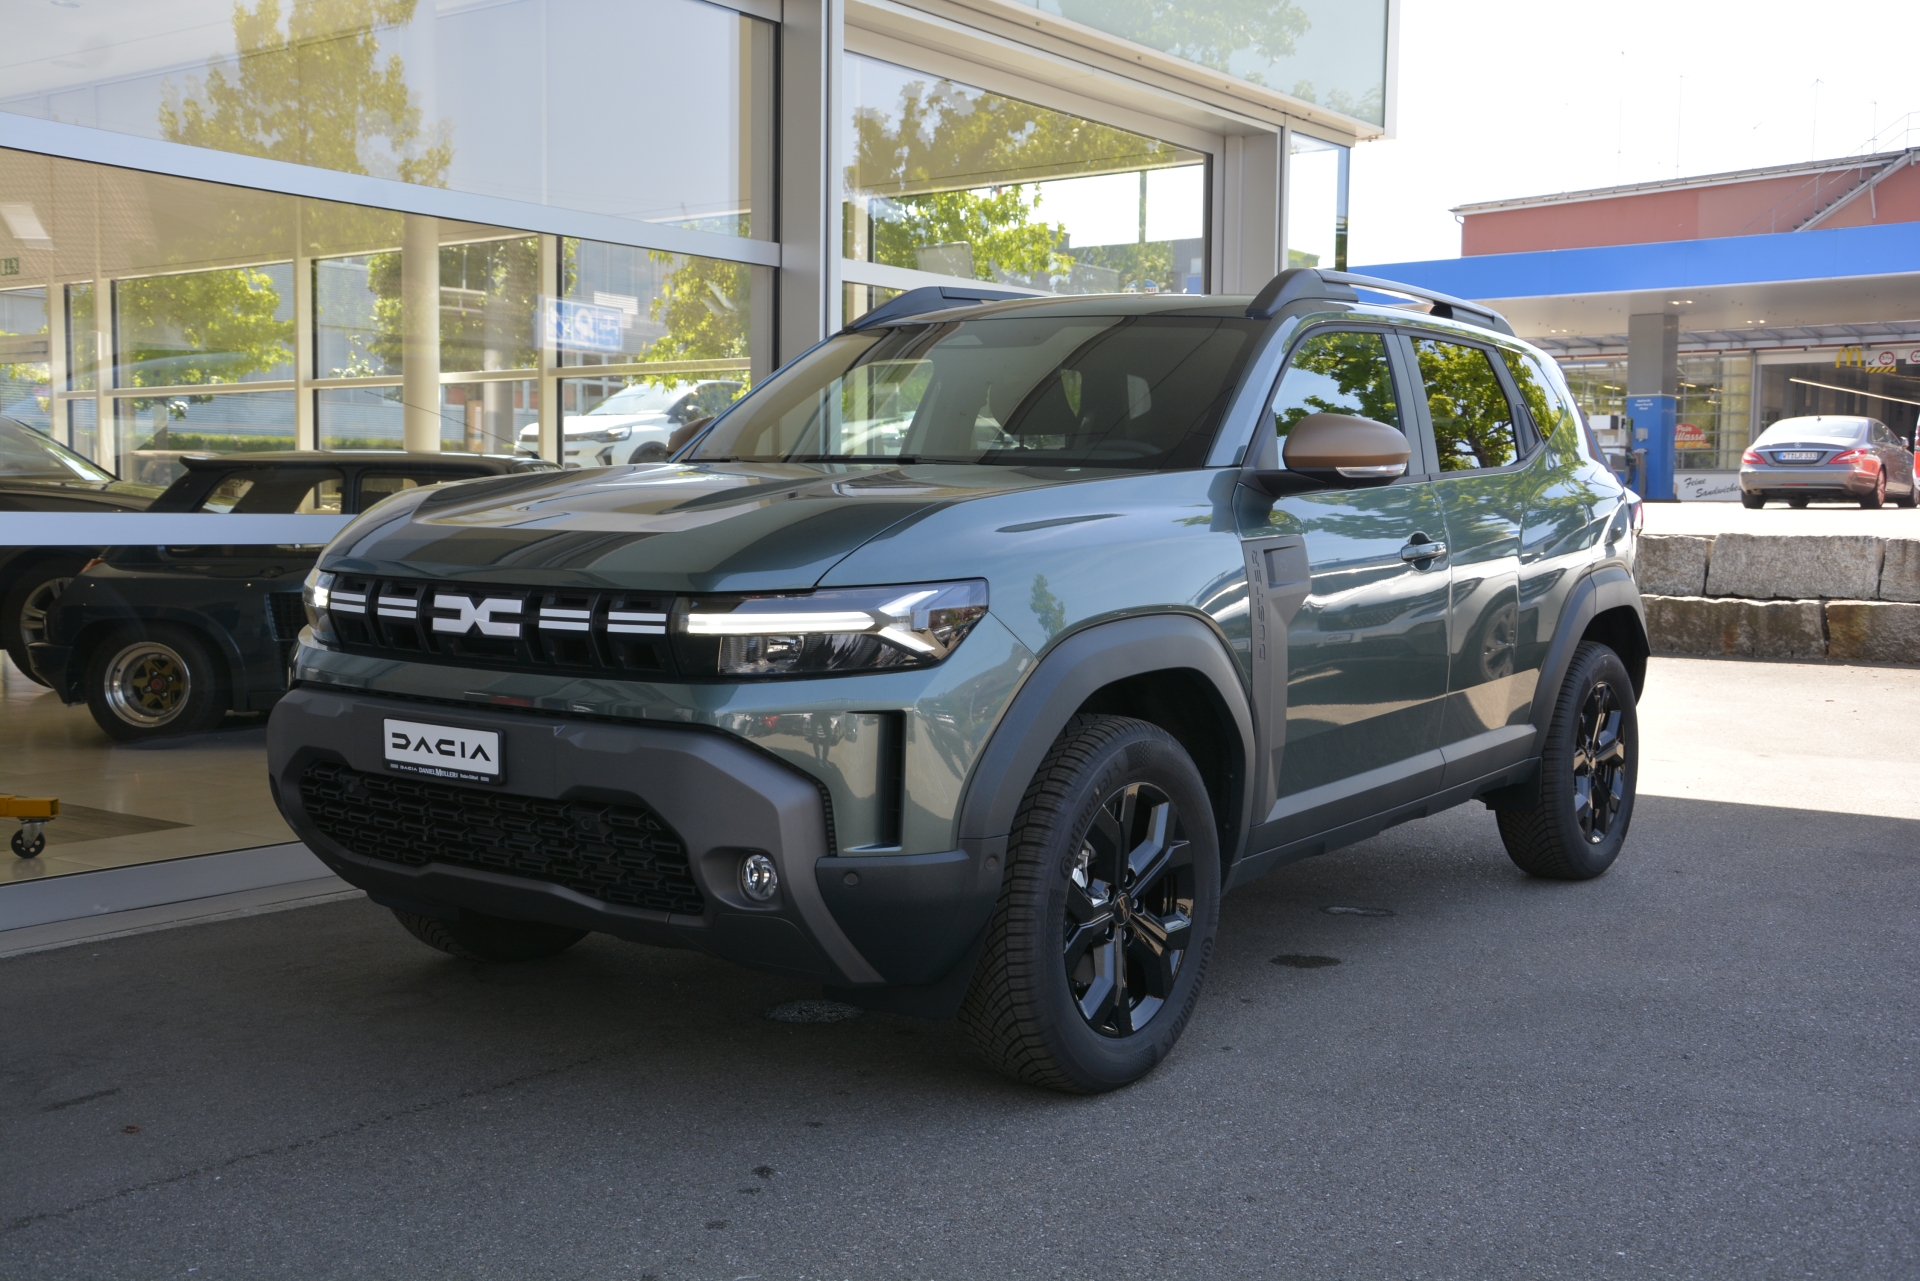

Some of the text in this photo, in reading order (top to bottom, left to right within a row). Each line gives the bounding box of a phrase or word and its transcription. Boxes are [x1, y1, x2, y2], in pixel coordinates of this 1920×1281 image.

[1684, 477, 1706, 489] Feine
[391, 731, 492, 762] DACIA
[399, 764, 418, 772] DACIA
[1059, 768, 1114, 881] Continental
[1168, 936, 1214, 1043] Continental
